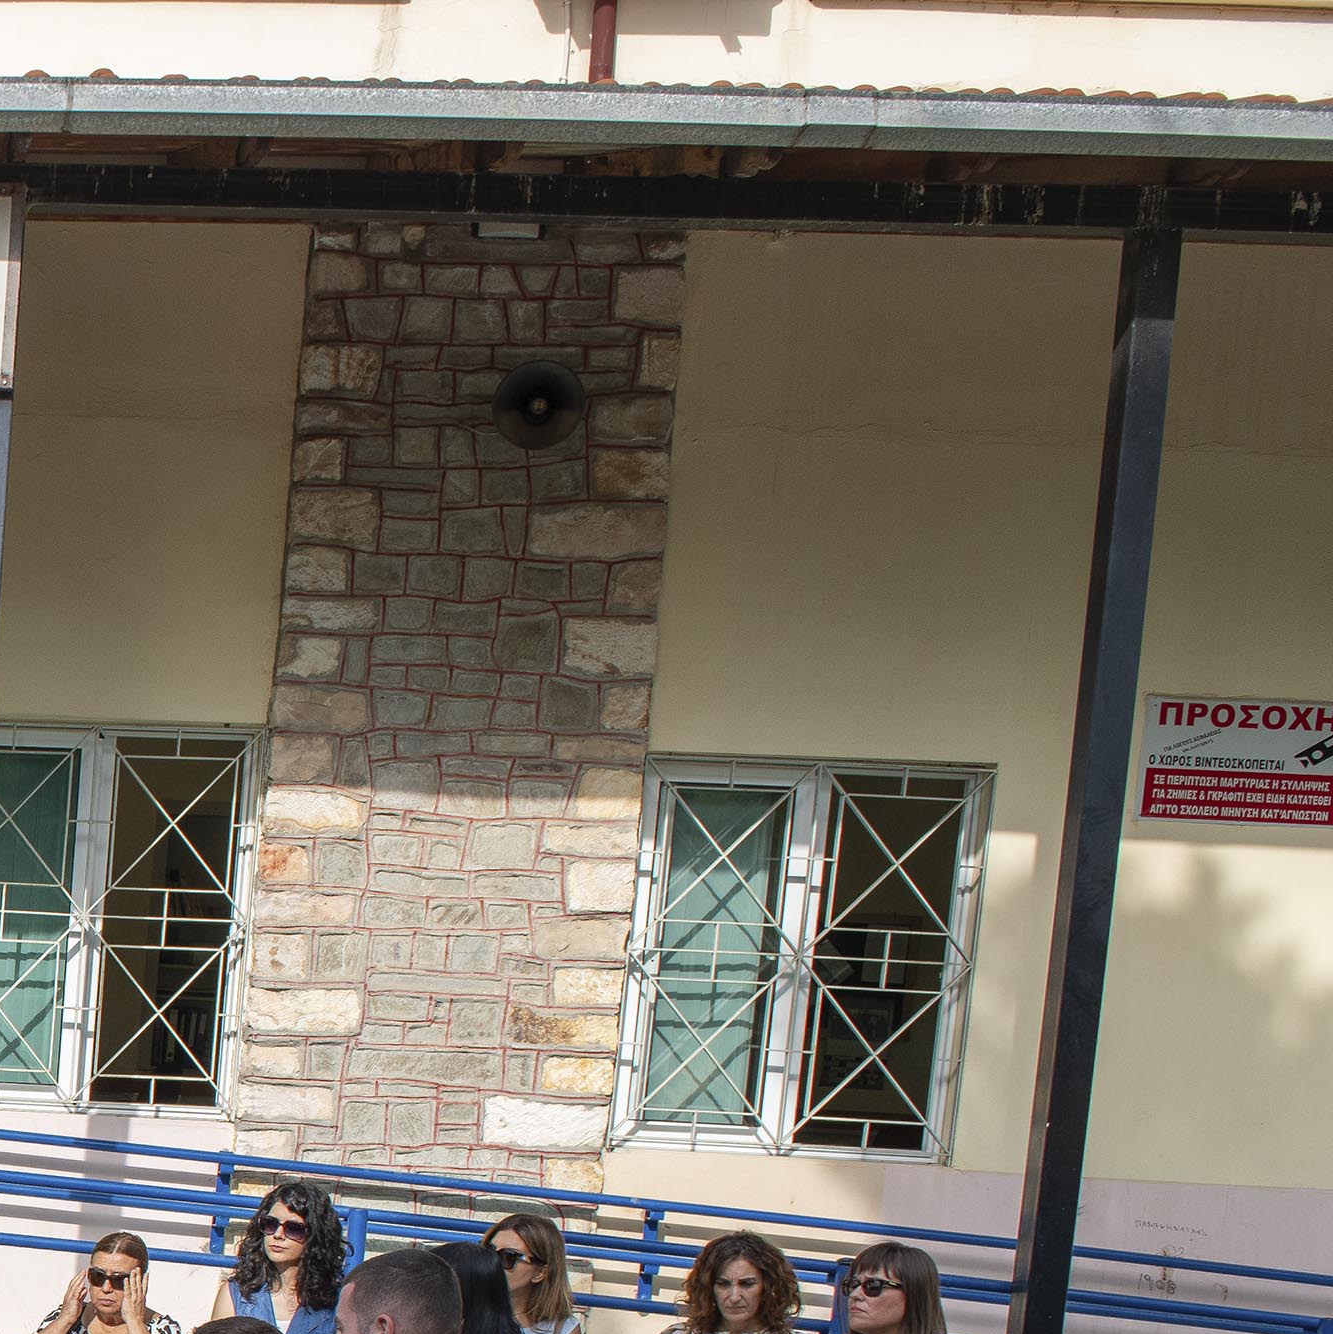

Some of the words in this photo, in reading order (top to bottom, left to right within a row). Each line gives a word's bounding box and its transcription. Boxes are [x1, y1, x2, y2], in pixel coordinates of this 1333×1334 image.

[1158, 755, 1192, 767] ΧΩΡΟΣ
[1195, 757, 1285, 771] ΒΙΝΤΕΟΣΚΟΠΕΙΤΑΙ
[1153, 775, 1165, 785] ΣΕ
[1167, 775, 1218, 787] ΠΕΡΙΠΤΩΣΗ
[1220, 777, 1270, 789] ΜΑΡΤΥΡΙΑΣ
[1281, 780, 1330, 791] ΣΥΛΛΗΨΗΣ
[1152, 789, 1165, 798] ΓΙΑ
[1167, 789, 1198, 800] ΖΗΜΙΕΣ
[1199, 791, 1206, 800] &
[1207, 791, 1244, 802] ΓΚΡΑΦΙΤΙ
[1247, 793, 1264, 803] ΕΧΕΙ
[1266, 794, 1285, 804] ΕΙΔΗ
[1287, 795, 1331, 806] ΚΑΤΑΤΕΘΕΙ
[1180, 805, 1219, 816] ΣΧΟΛΕΙΟ
[1221, 807, 1259, 818] ΜΗΝΥΣΗ
